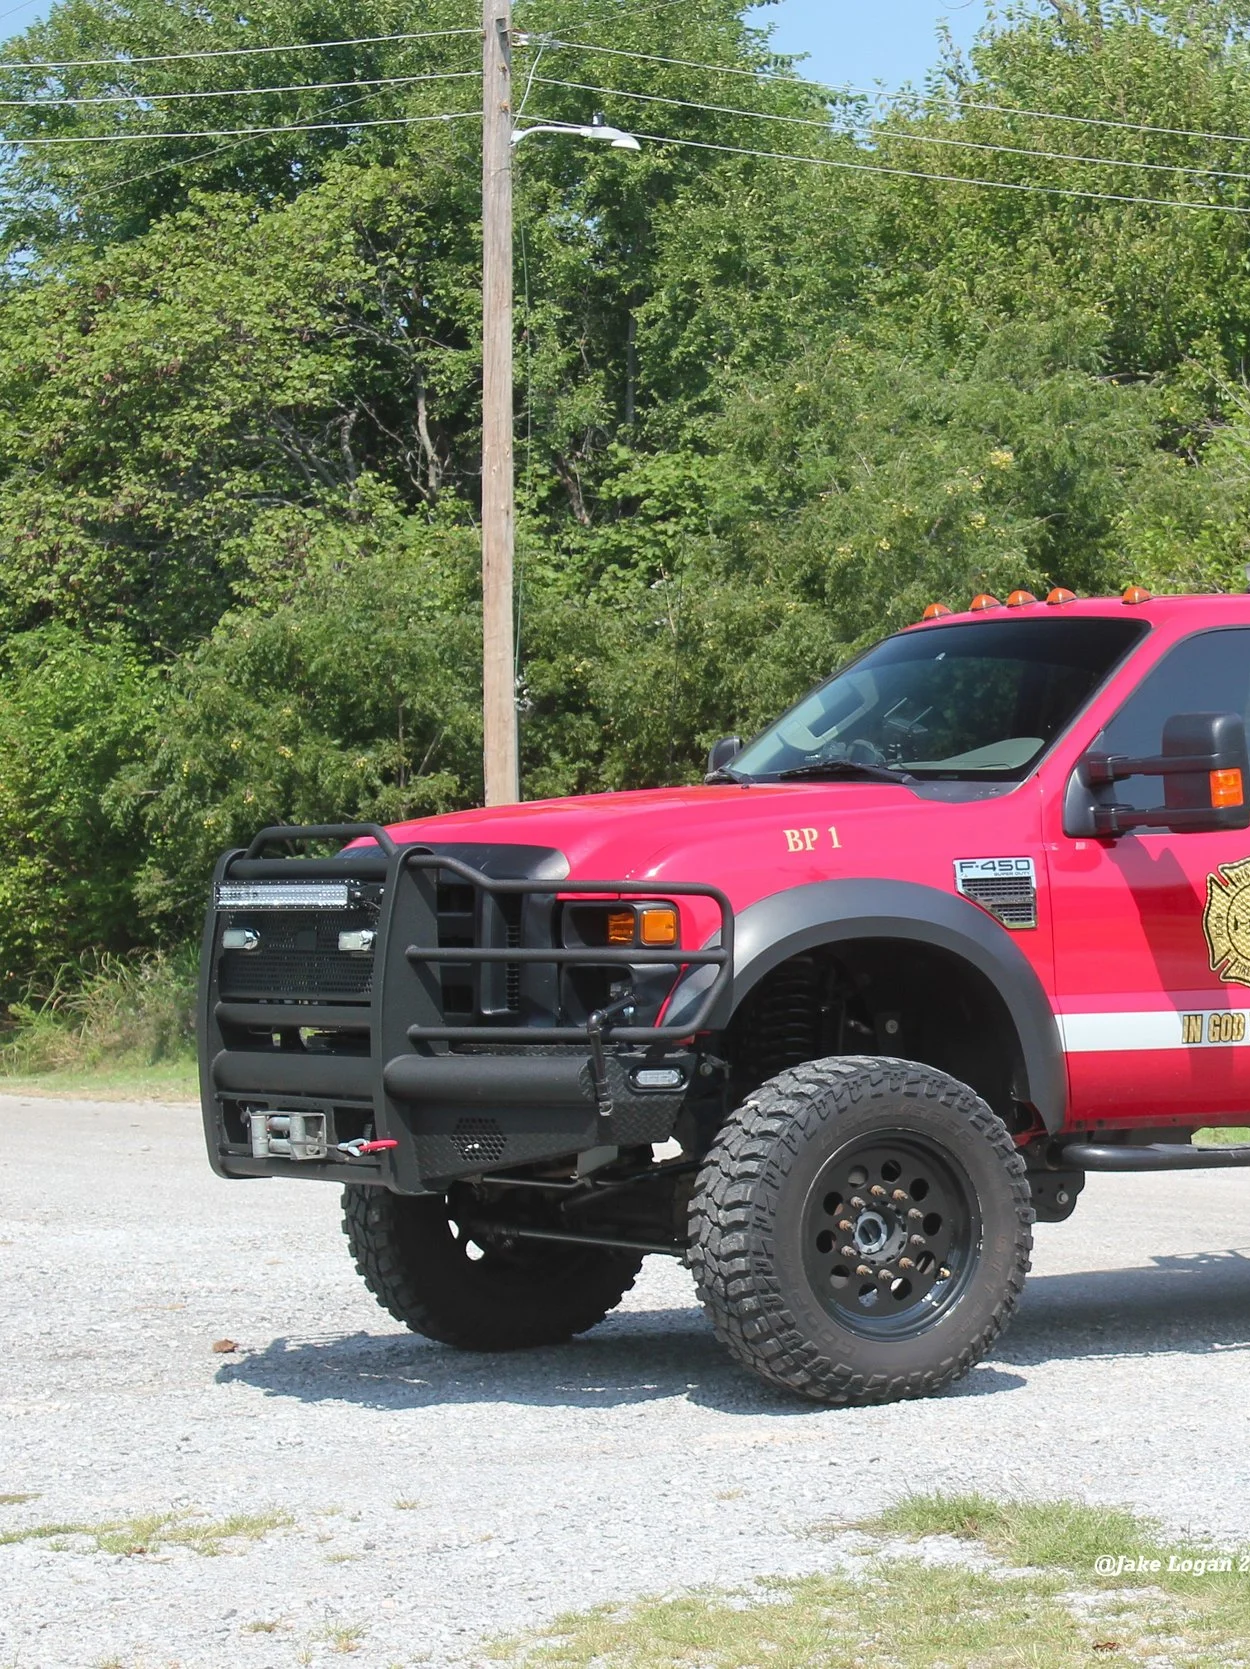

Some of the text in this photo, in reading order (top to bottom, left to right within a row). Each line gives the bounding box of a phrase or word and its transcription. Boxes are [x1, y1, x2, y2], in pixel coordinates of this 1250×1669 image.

[783, 825, 842, 852] BP 1
[959, 859, 1031, 873] F-450
[1182, 1014, 1203, 1044] IN
[1207, 1013, 1246, 1043] GOD
